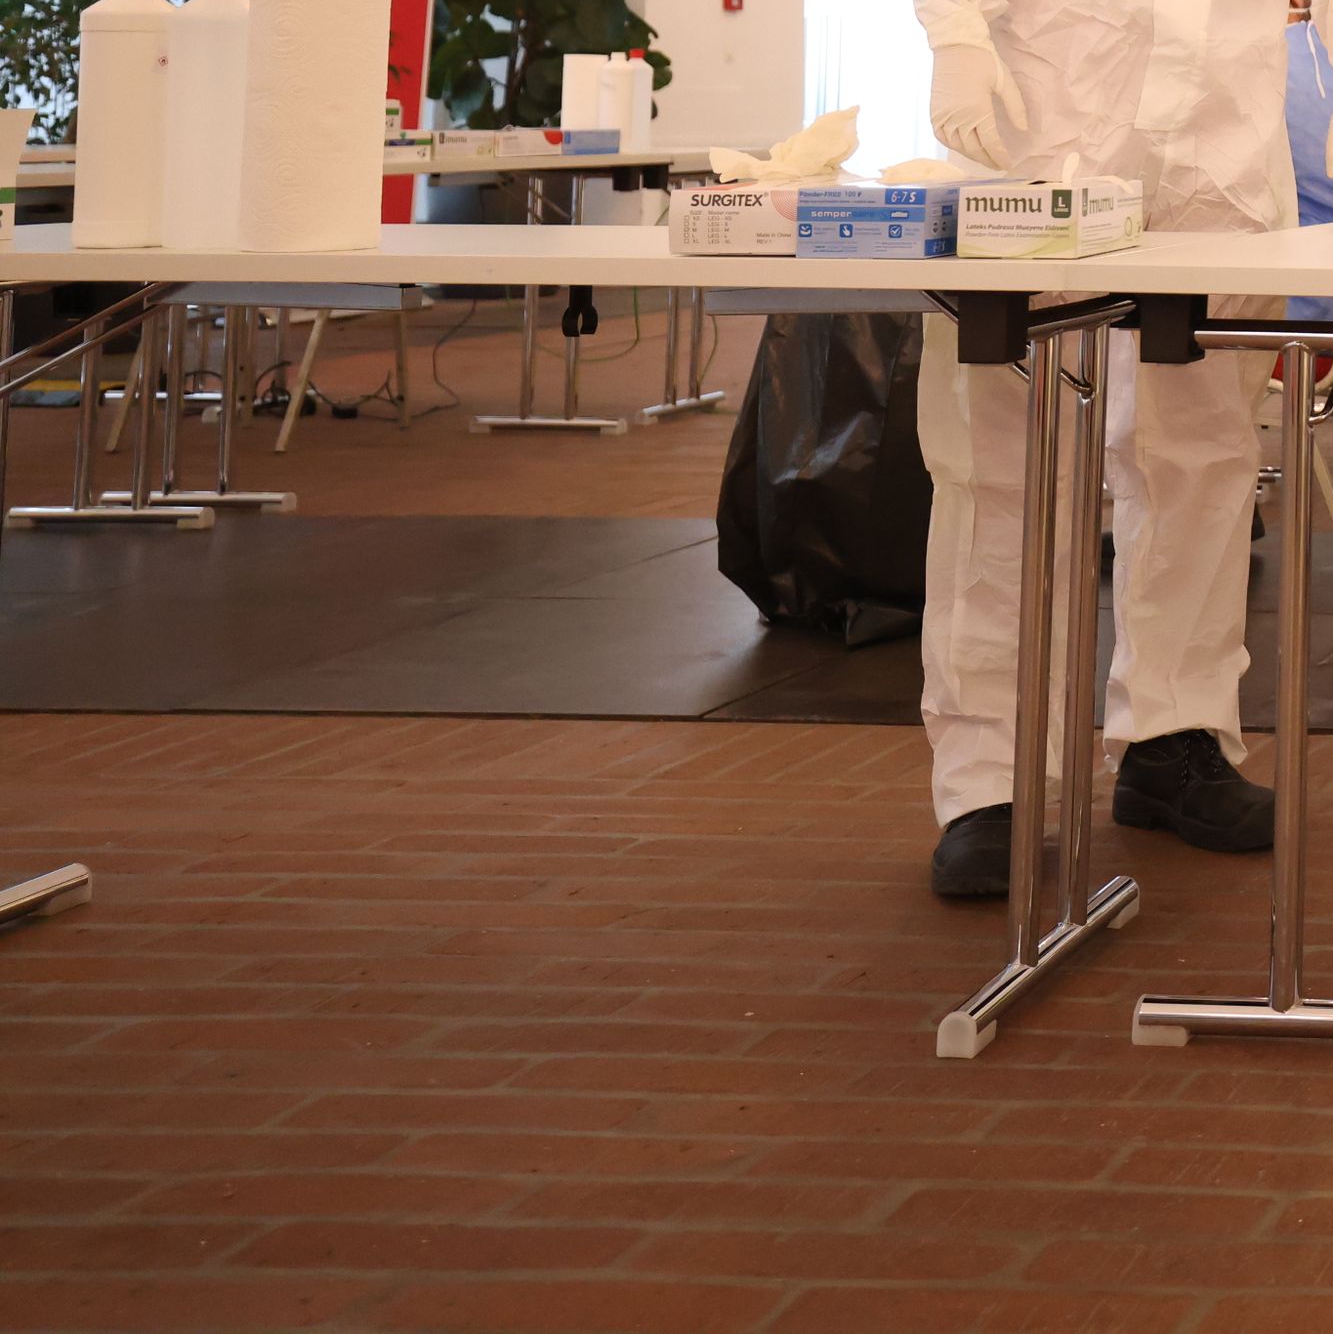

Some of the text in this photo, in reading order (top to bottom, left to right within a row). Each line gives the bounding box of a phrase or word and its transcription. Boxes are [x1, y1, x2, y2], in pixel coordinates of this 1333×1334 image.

[690, 194, 763, 207] SURGITEX
[965, 196, 1042, 213] mumu
[1058, 196, 1066, 207] L
